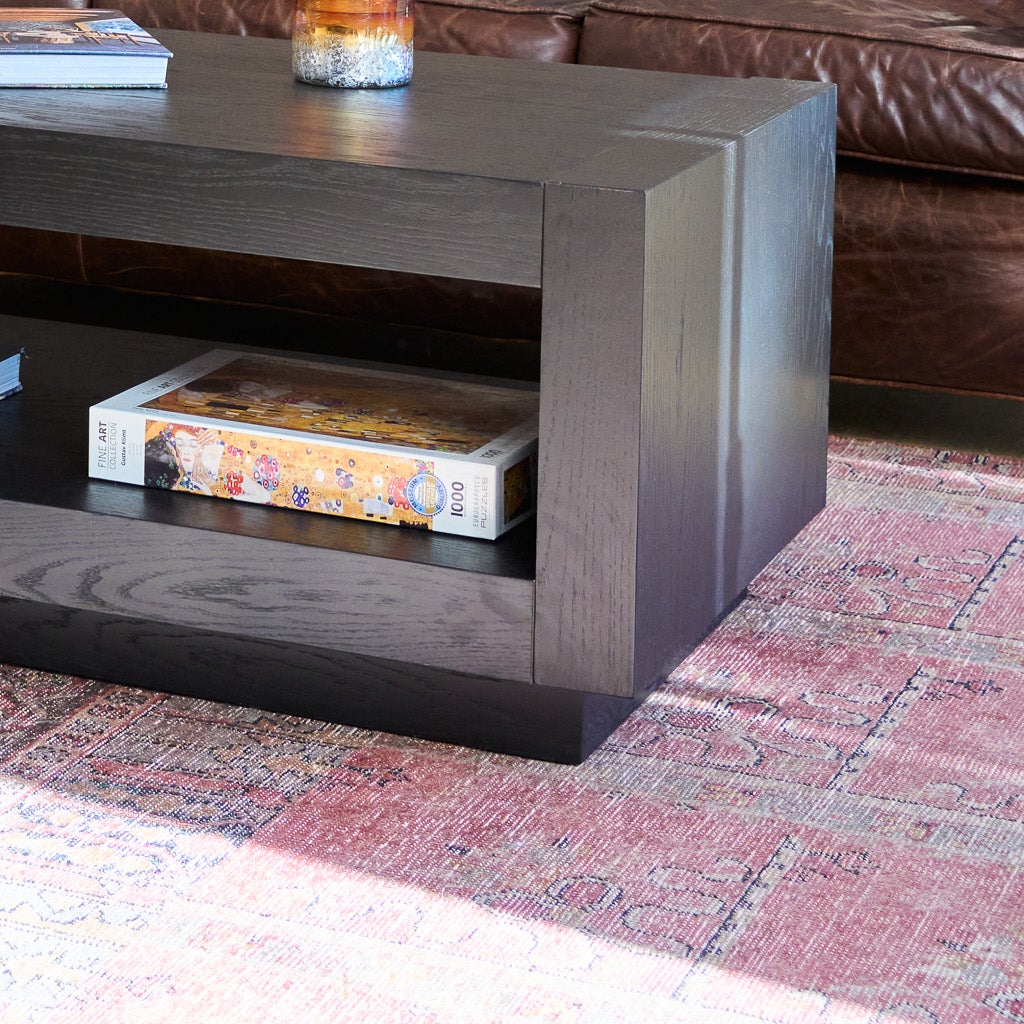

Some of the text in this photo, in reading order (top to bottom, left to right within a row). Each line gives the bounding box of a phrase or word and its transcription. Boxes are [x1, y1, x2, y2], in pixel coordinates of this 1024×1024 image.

[97, 420, 107, 468] FINE ART
[109, 422, 117, 470] COLLECTION
[408, 478, 419, 508] MUSEUM
[450, 481, 464, 517] 1000
[480, 476, 488, 529] PUZZLES
